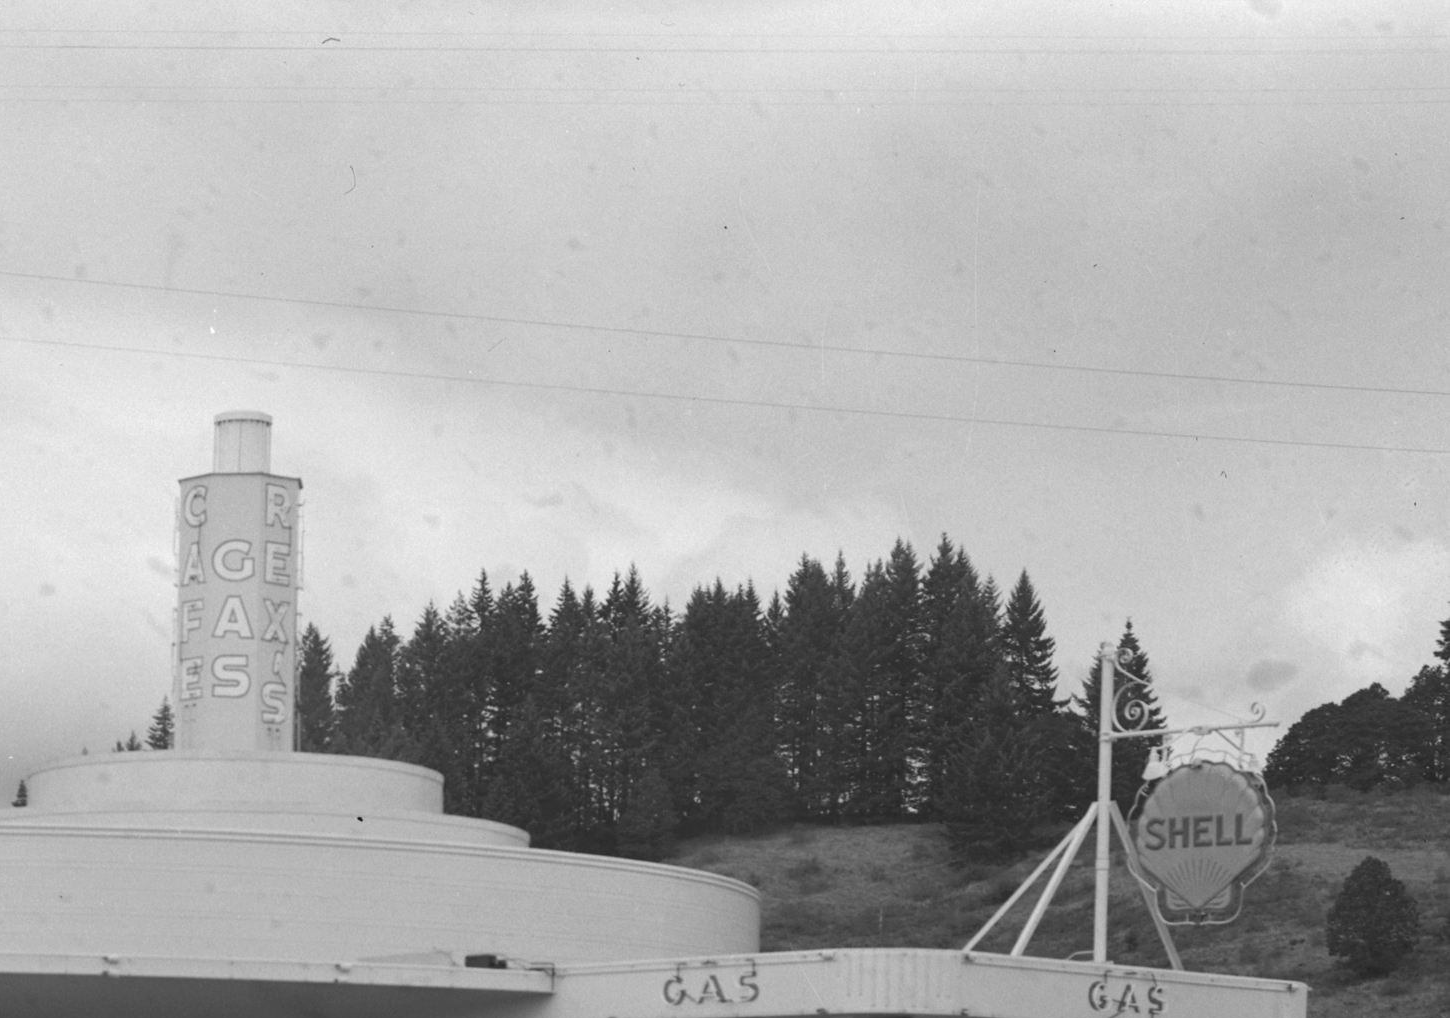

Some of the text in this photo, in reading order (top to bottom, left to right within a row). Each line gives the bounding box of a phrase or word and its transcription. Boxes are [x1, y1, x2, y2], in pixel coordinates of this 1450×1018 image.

[181, 485, 207, 701] CAFE
[211, 538, 255, 699] GAS
[1145, 813, 1253, 851] SHELL
[663, 973, 760, 1006] GAS
[1088, 980, 1164, 1016] GAS
